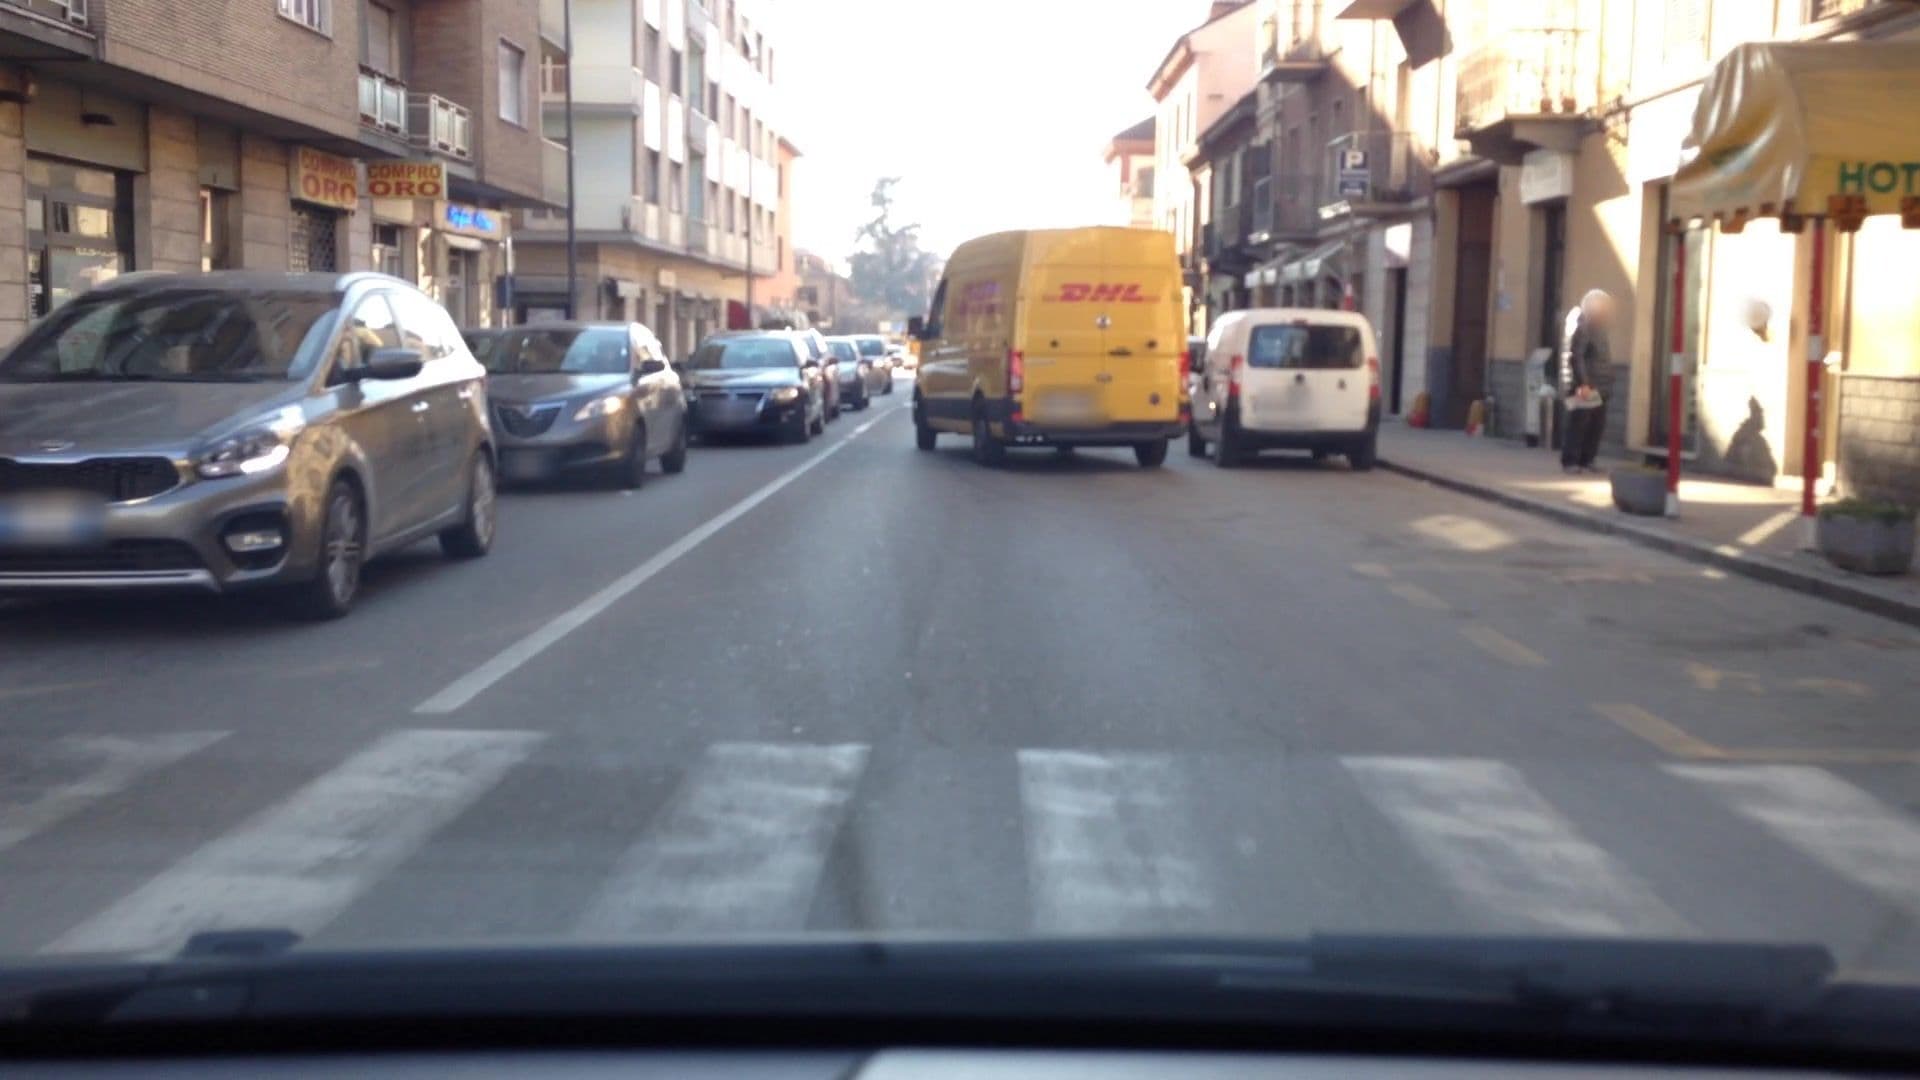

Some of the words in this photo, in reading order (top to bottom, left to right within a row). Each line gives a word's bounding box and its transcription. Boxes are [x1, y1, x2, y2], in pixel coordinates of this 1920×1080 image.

[1346, 151, 1363, 169] P
[368, 165, 441, 178] COMPRO
[302, 173, 357, 202] ORO
[368, 181, 441, 196] ORO
[1060, 283, 1142, 302] DHL
